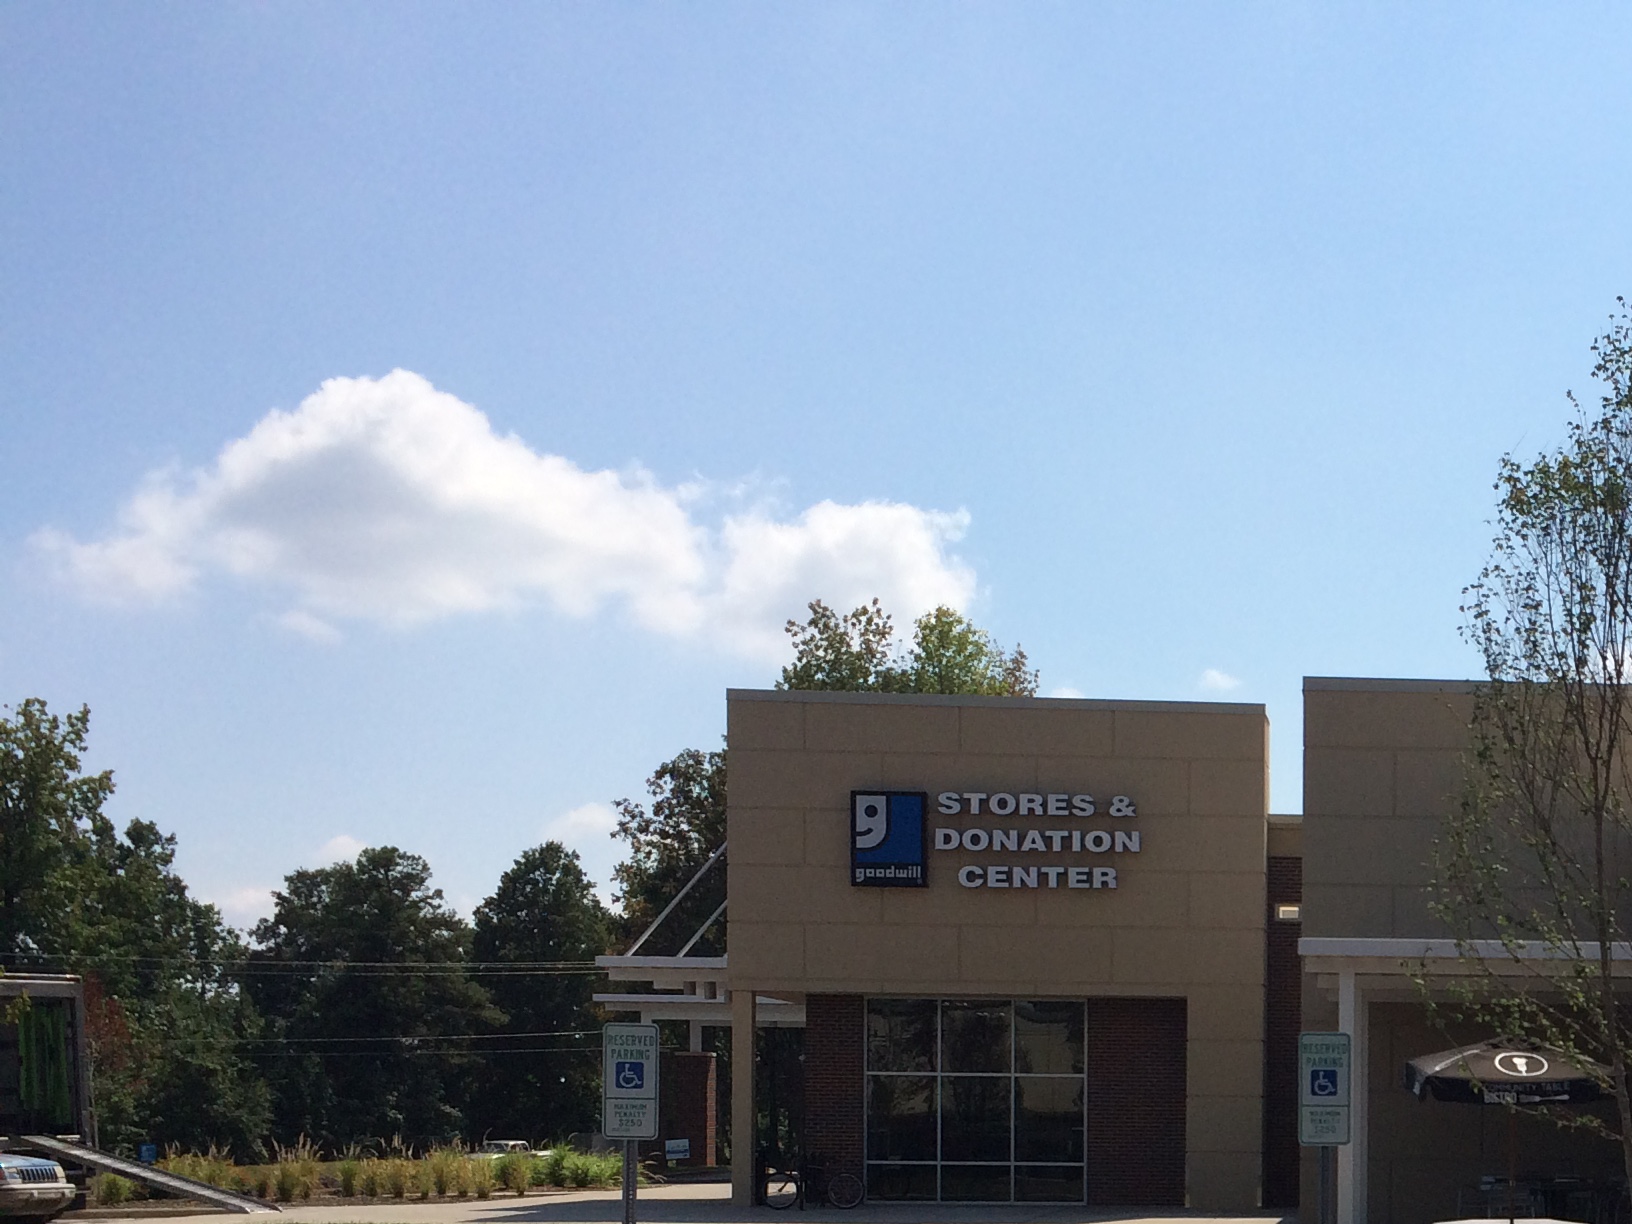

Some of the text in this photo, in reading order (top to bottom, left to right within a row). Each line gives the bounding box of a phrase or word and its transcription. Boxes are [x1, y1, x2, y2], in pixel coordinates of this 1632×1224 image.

[937, 791, 1137, 818] STORES &
[934, 827, 1141, 853] DONATION
[856, 866, 922, 883] goodwill
[957, 865, 1118, 889] CENTER
[607, 1034, 655, 1046] RESERVED
[611, 1049, 650, 1060] PARKING
